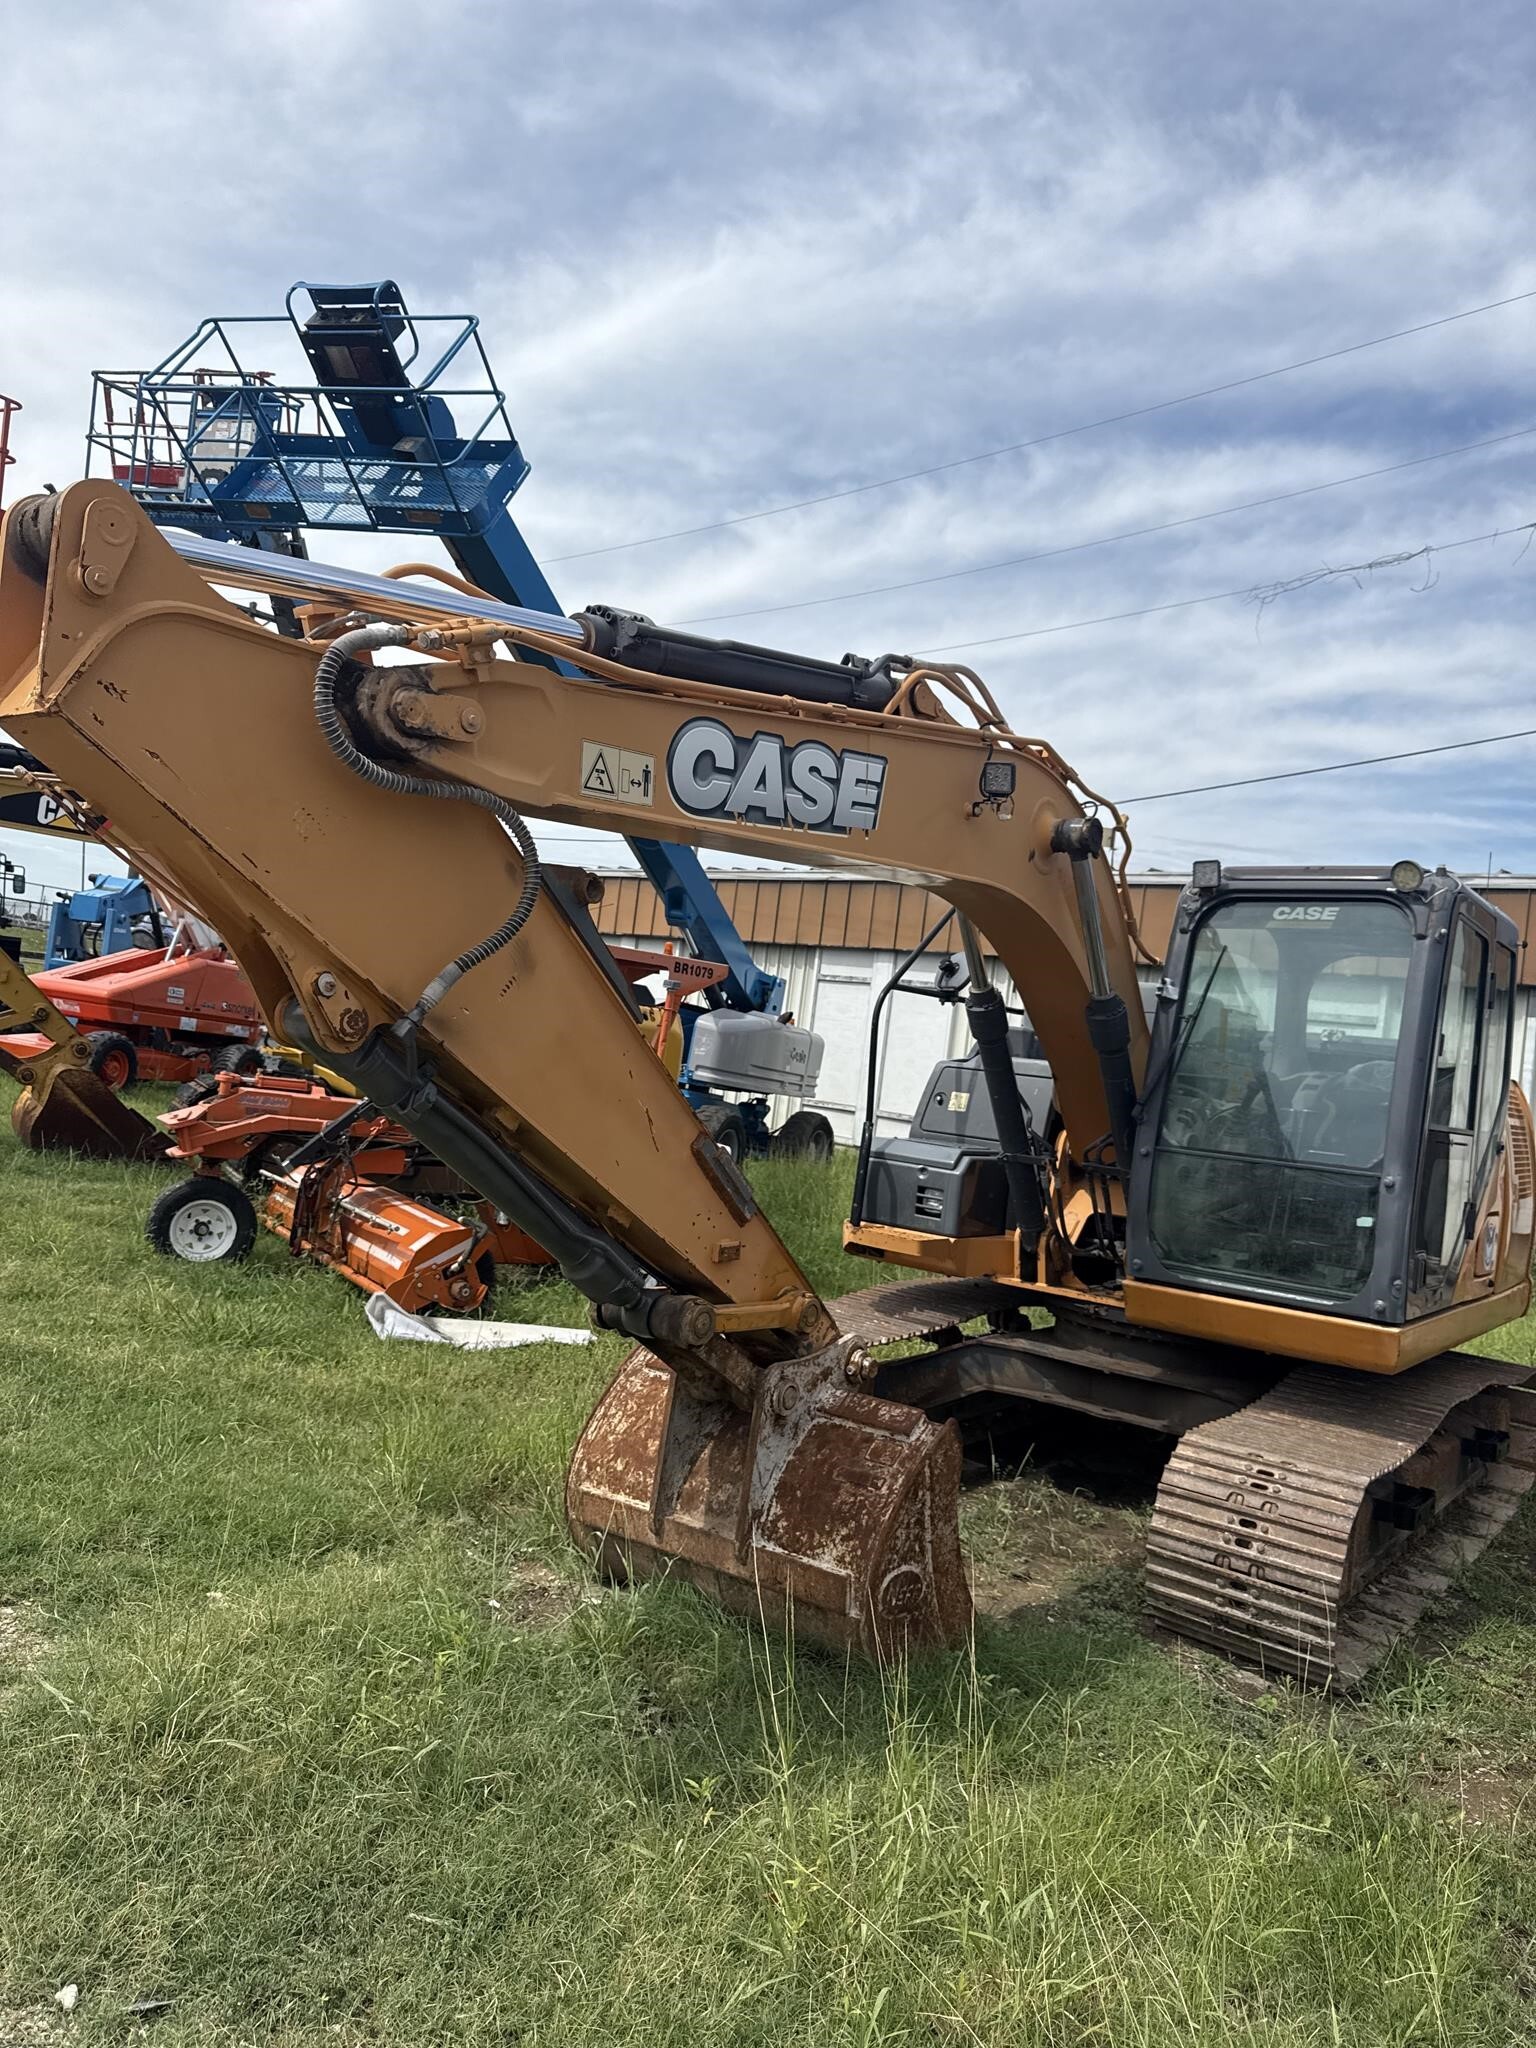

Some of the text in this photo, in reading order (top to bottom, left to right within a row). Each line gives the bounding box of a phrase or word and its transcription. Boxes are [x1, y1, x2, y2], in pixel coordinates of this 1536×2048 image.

[670, 724, 885, 831] CASE
[1272, 906, 1340, 920] CASE
[673, 961, 714, 979] BR1079
